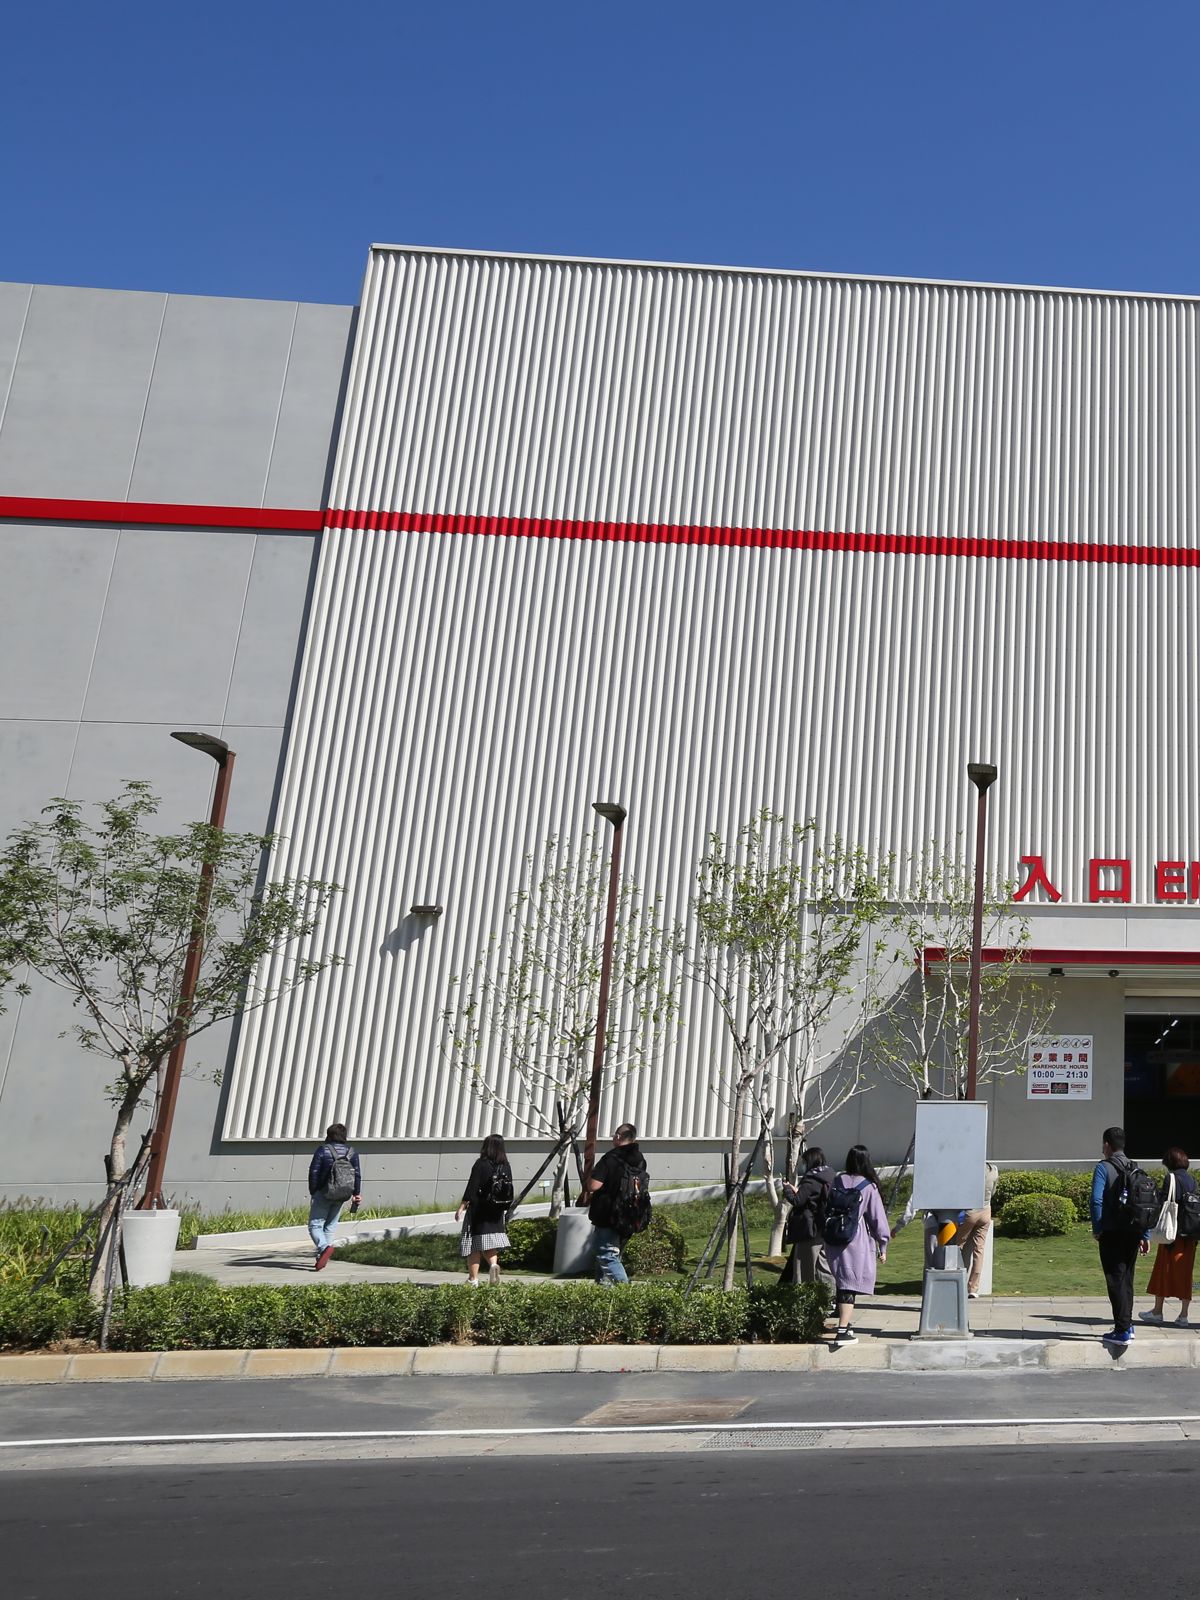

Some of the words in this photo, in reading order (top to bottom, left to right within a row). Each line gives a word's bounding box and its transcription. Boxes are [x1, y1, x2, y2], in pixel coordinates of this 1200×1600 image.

[1012, 855, 1131, 902] 入口
[1032, 1070, 1055, 1079] 10:00
[1066, 1070, 1089, 1079] 21:30
